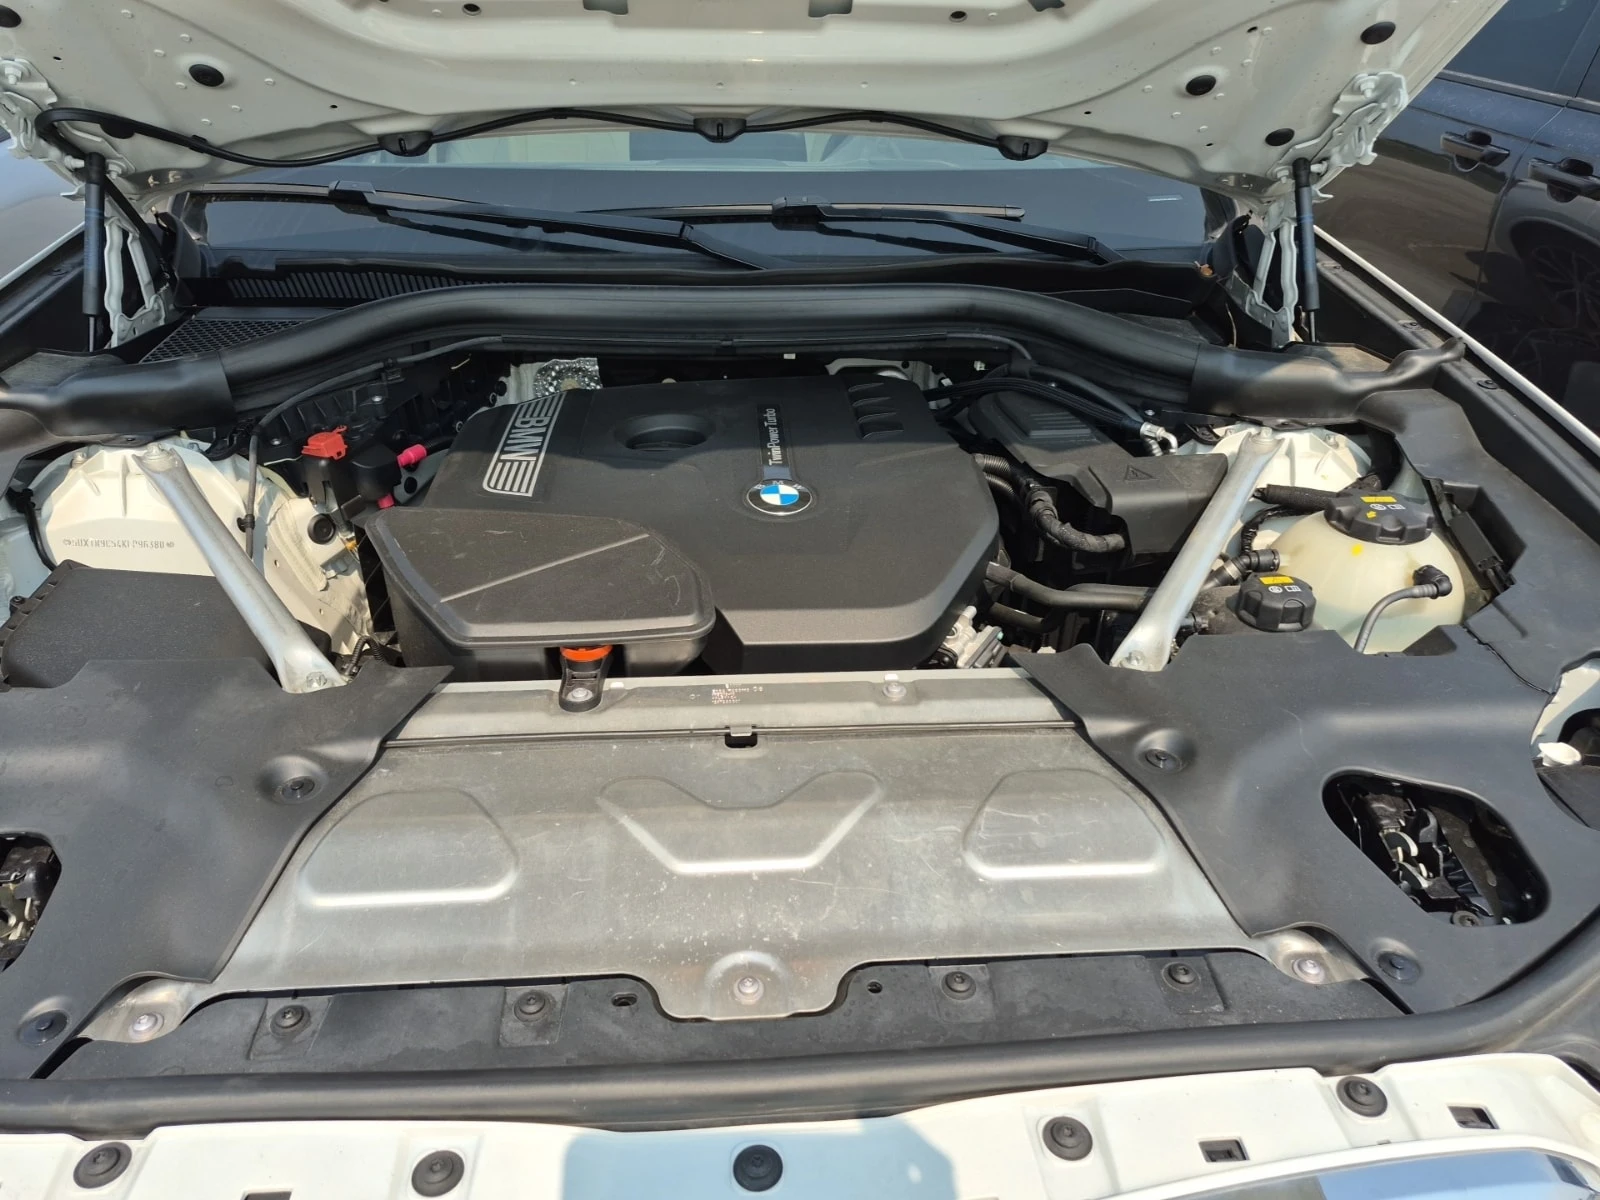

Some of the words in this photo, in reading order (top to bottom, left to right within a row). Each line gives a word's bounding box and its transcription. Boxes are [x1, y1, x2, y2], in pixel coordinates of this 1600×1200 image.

[763, 408, 777, 427] Turbo
[500, 416, 552, 461] BMW
[767, 427, 783, 466] TwinPower
